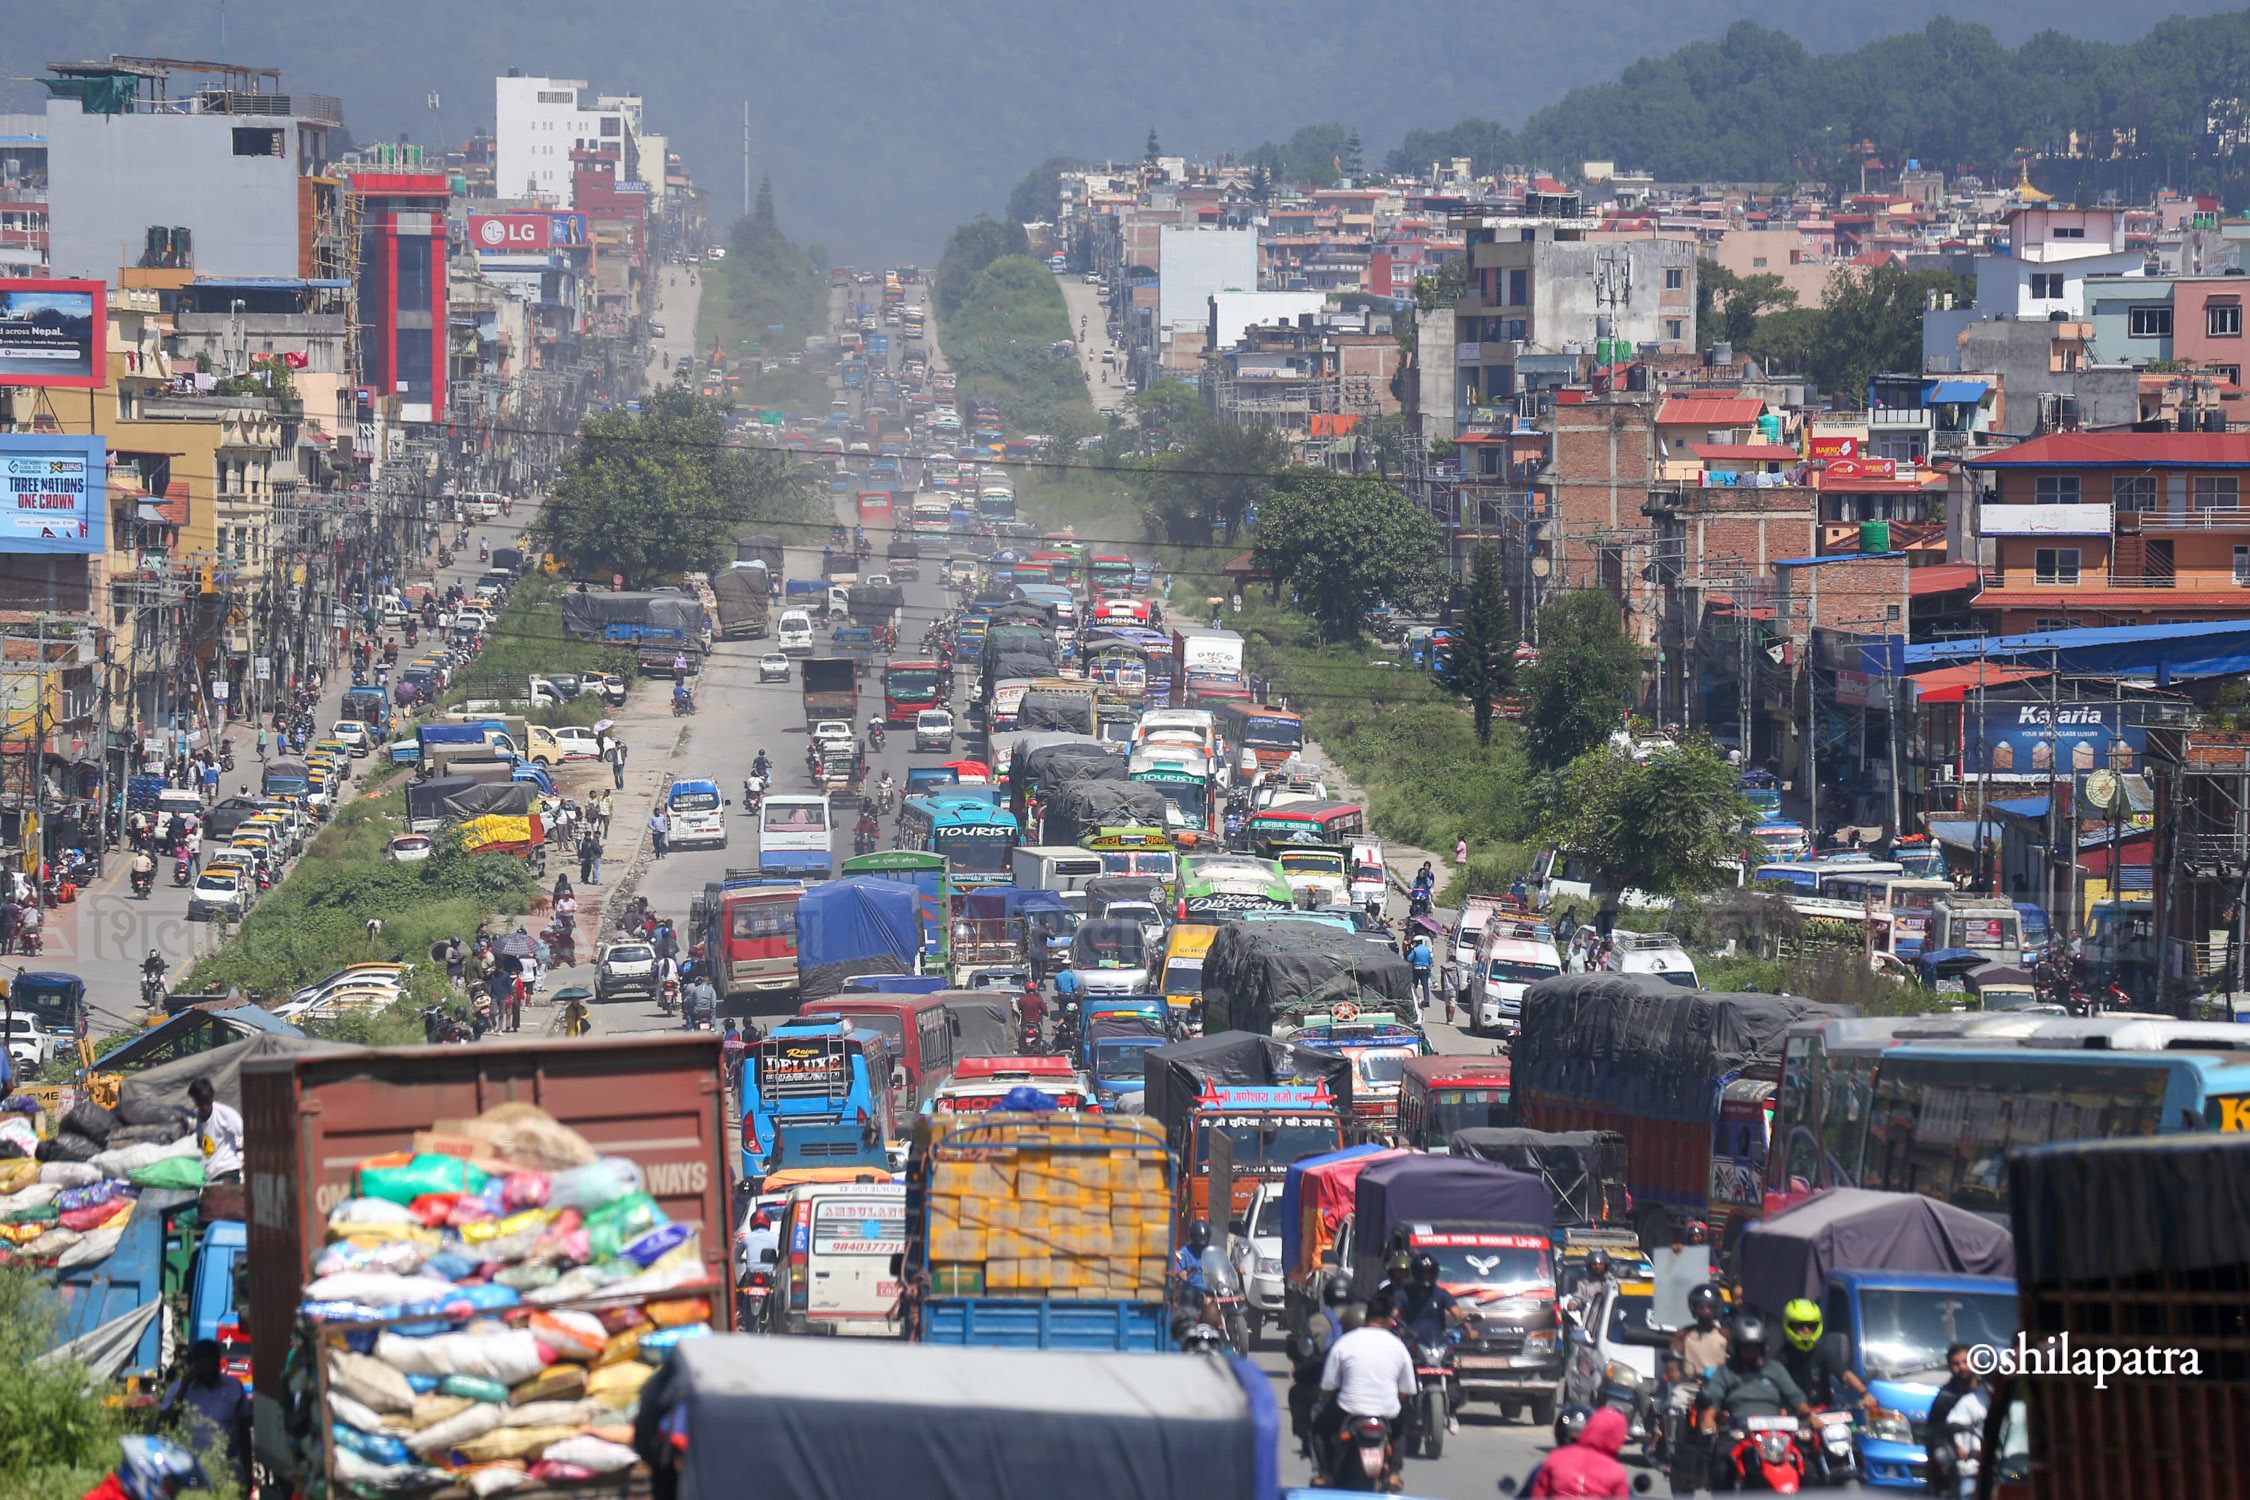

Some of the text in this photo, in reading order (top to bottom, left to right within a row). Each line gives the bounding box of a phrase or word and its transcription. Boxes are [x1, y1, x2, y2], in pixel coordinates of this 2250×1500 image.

[509, 223, 535, 241] LG
[32, 326, 63, 336] Nepal.
[9, 477, 84, 493] THREE NATIONS
[18, 494, 74, 509] ONE CROWN
[1096, 617, 1146, 625] KARNALI
[1143, 773, 1195, 783] TOURIST
[937, 827, 1015, 837] TOURIST
[1188, 898, 1285, 911] Discovery
[766, 1056, 840, 1073] DELUXE
[659, 1163, 707, 1194] WAYS
